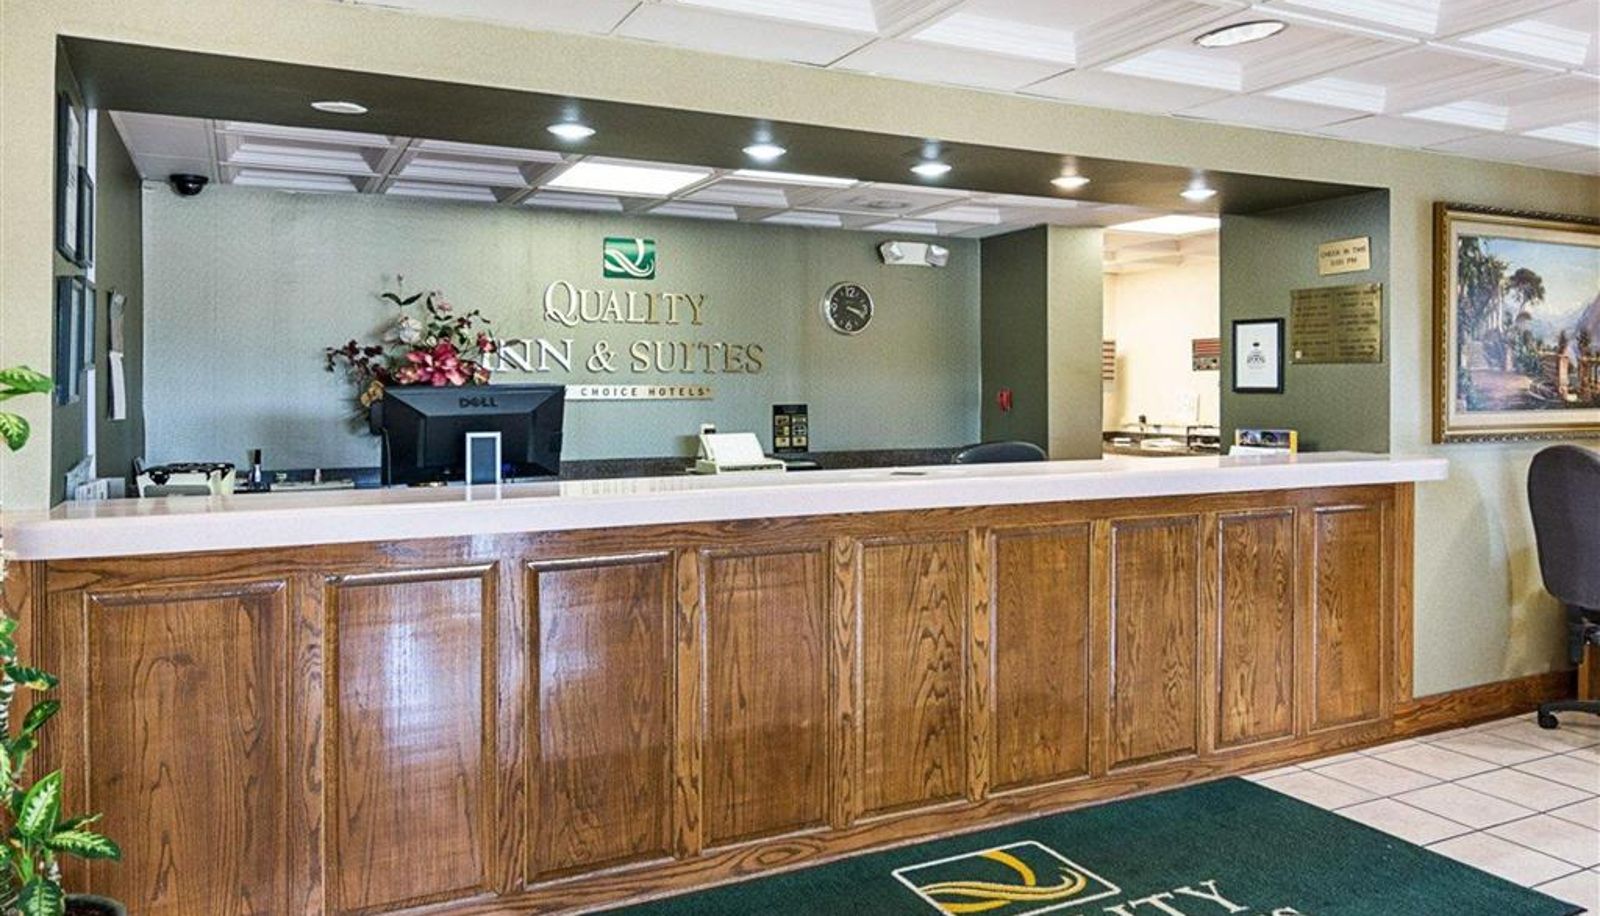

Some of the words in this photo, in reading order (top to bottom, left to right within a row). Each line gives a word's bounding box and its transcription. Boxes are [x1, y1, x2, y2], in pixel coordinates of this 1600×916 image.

[845, 287, 856, 298] 12
[543, 280, 704, 327] QUALITY
[482, 338, 573, 373] INN
[585, 339, 616, 373] &
[629, 340, 764, 374] SUITES
[580, 387, 638, 397] CHOICE
[459, 396, 498, 408] DELL
